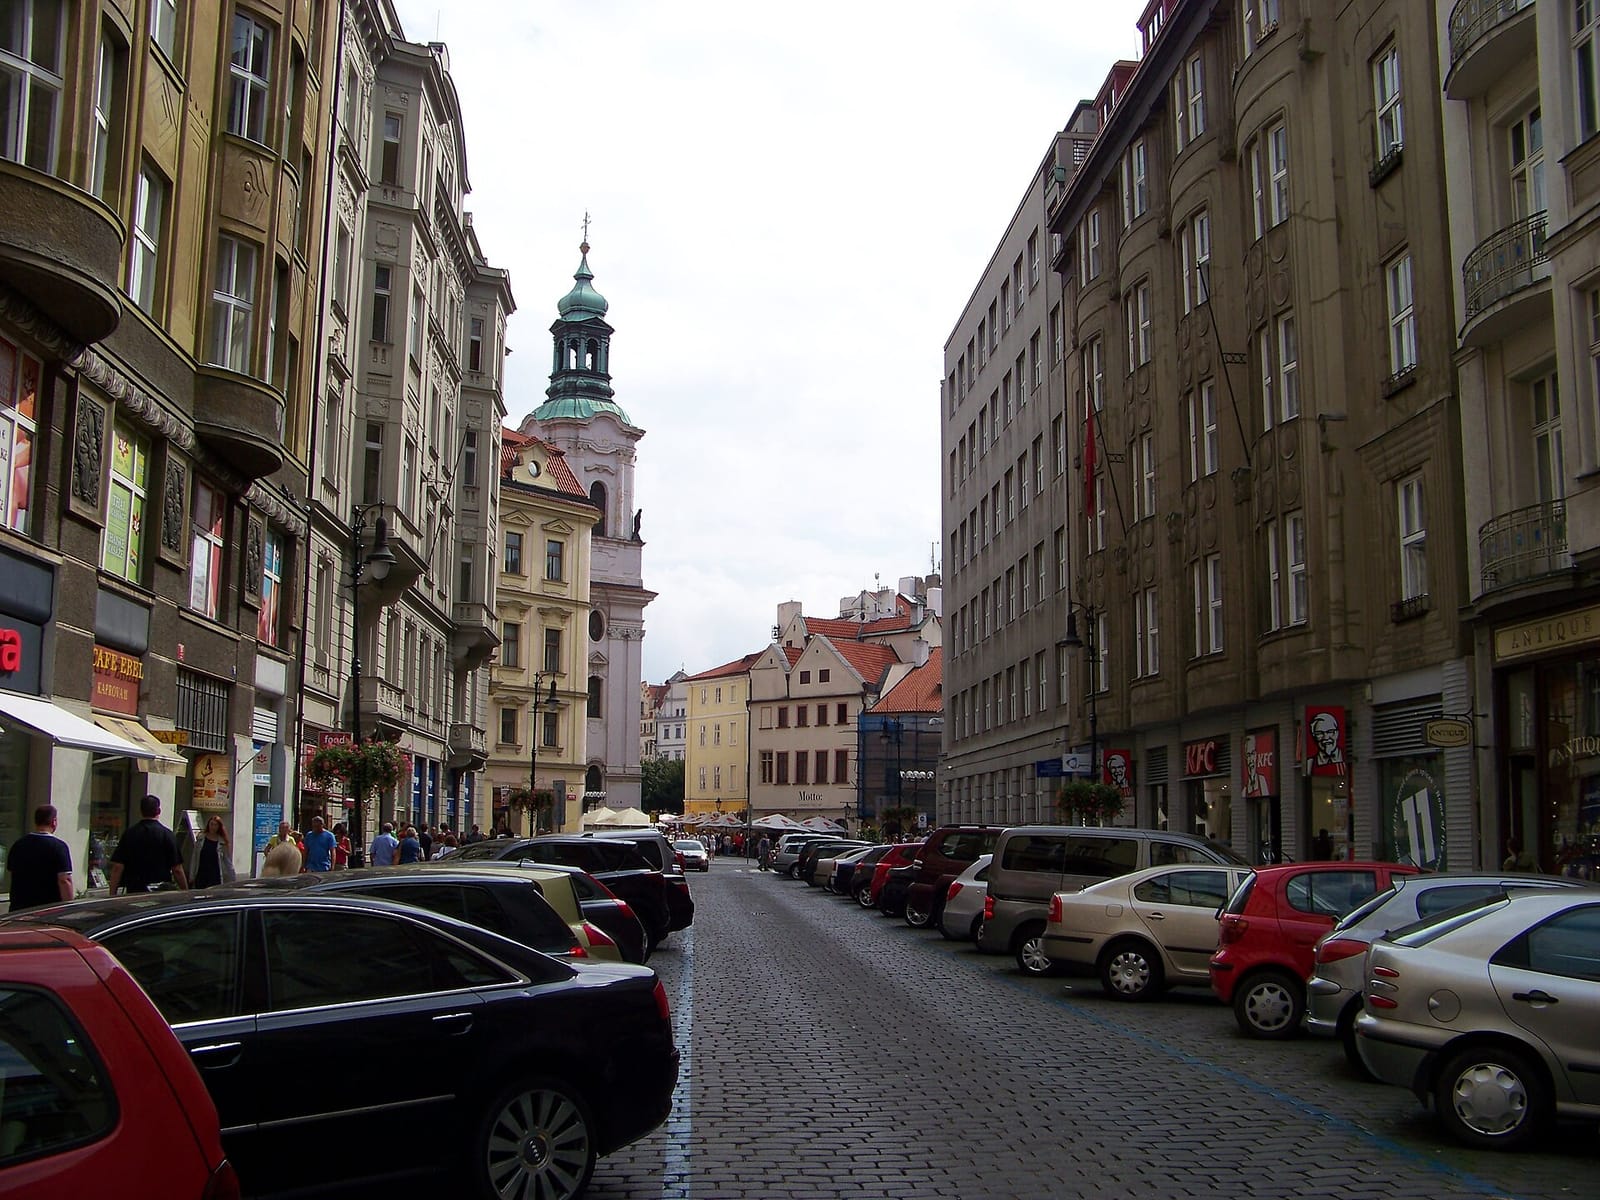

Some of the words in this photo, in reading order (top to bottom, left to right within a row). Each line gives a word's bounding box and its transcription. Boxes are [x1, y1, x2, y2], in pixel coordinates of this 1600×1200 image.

[1510, 614, 1593, 649] ANTIQUE
[120, 656, 144, 680] EBEL
[324, 734, 346, 745] food
[1431, 728, 1465, 737] ANTIQUE
[1184, 740, 1215, 775] KFC
[1257, 752, 1273, 768] KFC
[798, 790, 823, 802] Motto:
